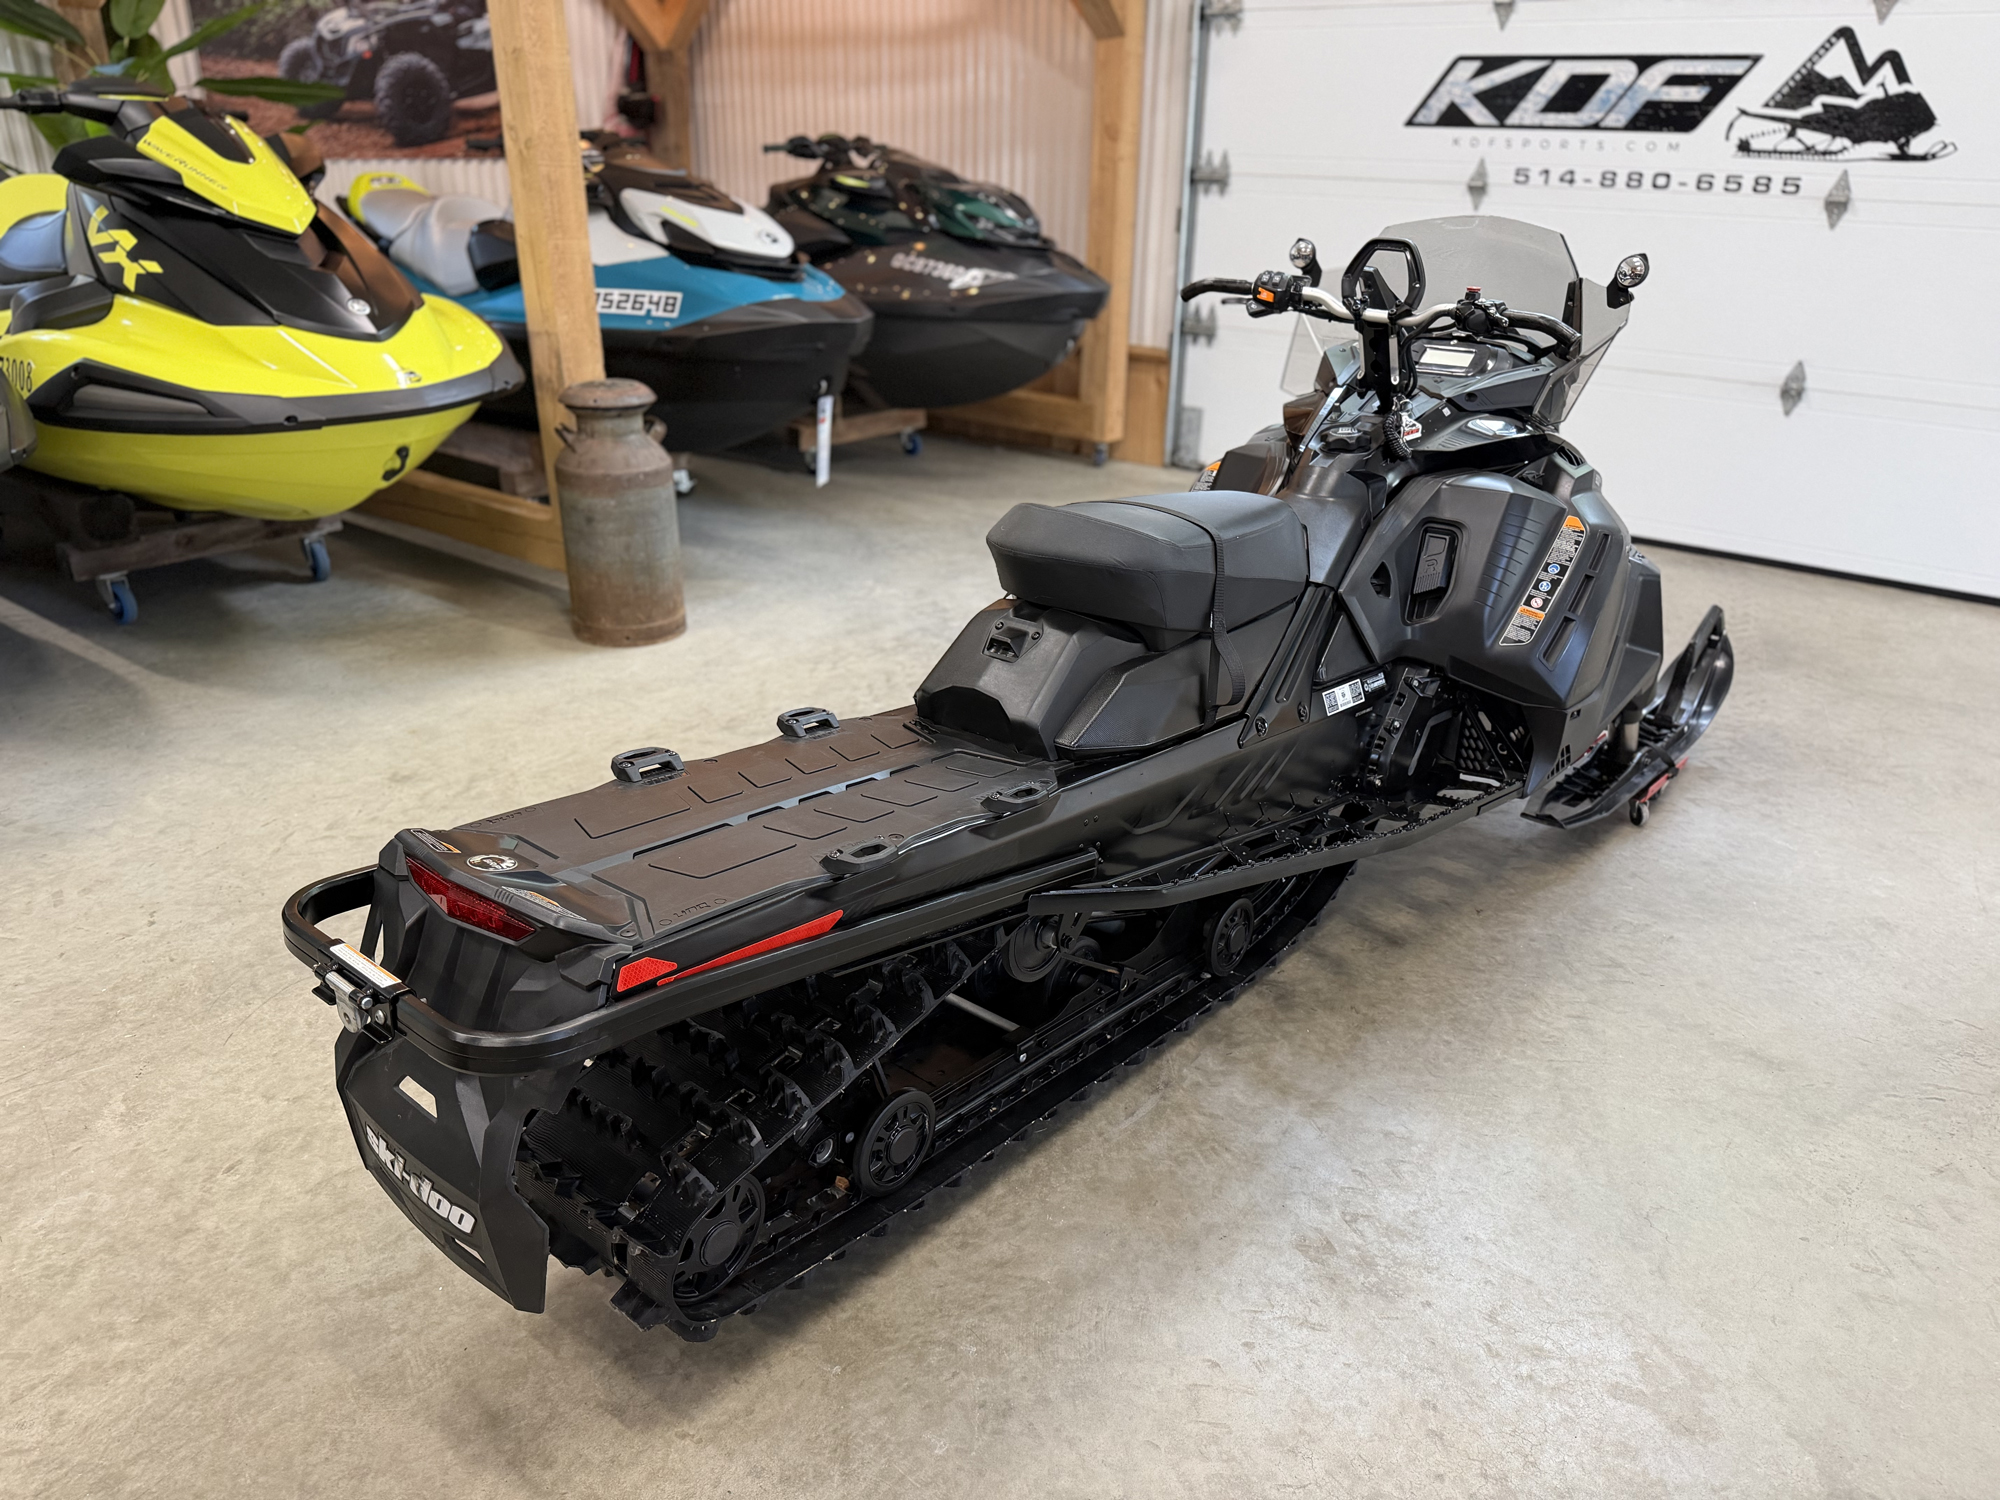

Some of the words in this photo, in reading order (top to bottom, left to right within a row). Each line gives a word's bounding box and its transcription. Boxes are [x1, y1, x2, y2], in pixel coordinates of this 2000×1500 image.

[1411, 58, 1754, 129] KDF
[1452, 136, 1681, 153] KDFSPORTS.COM
[1513, 166, 1803, 196] 514-880-6585
[87, 205, 164, 293] VX
